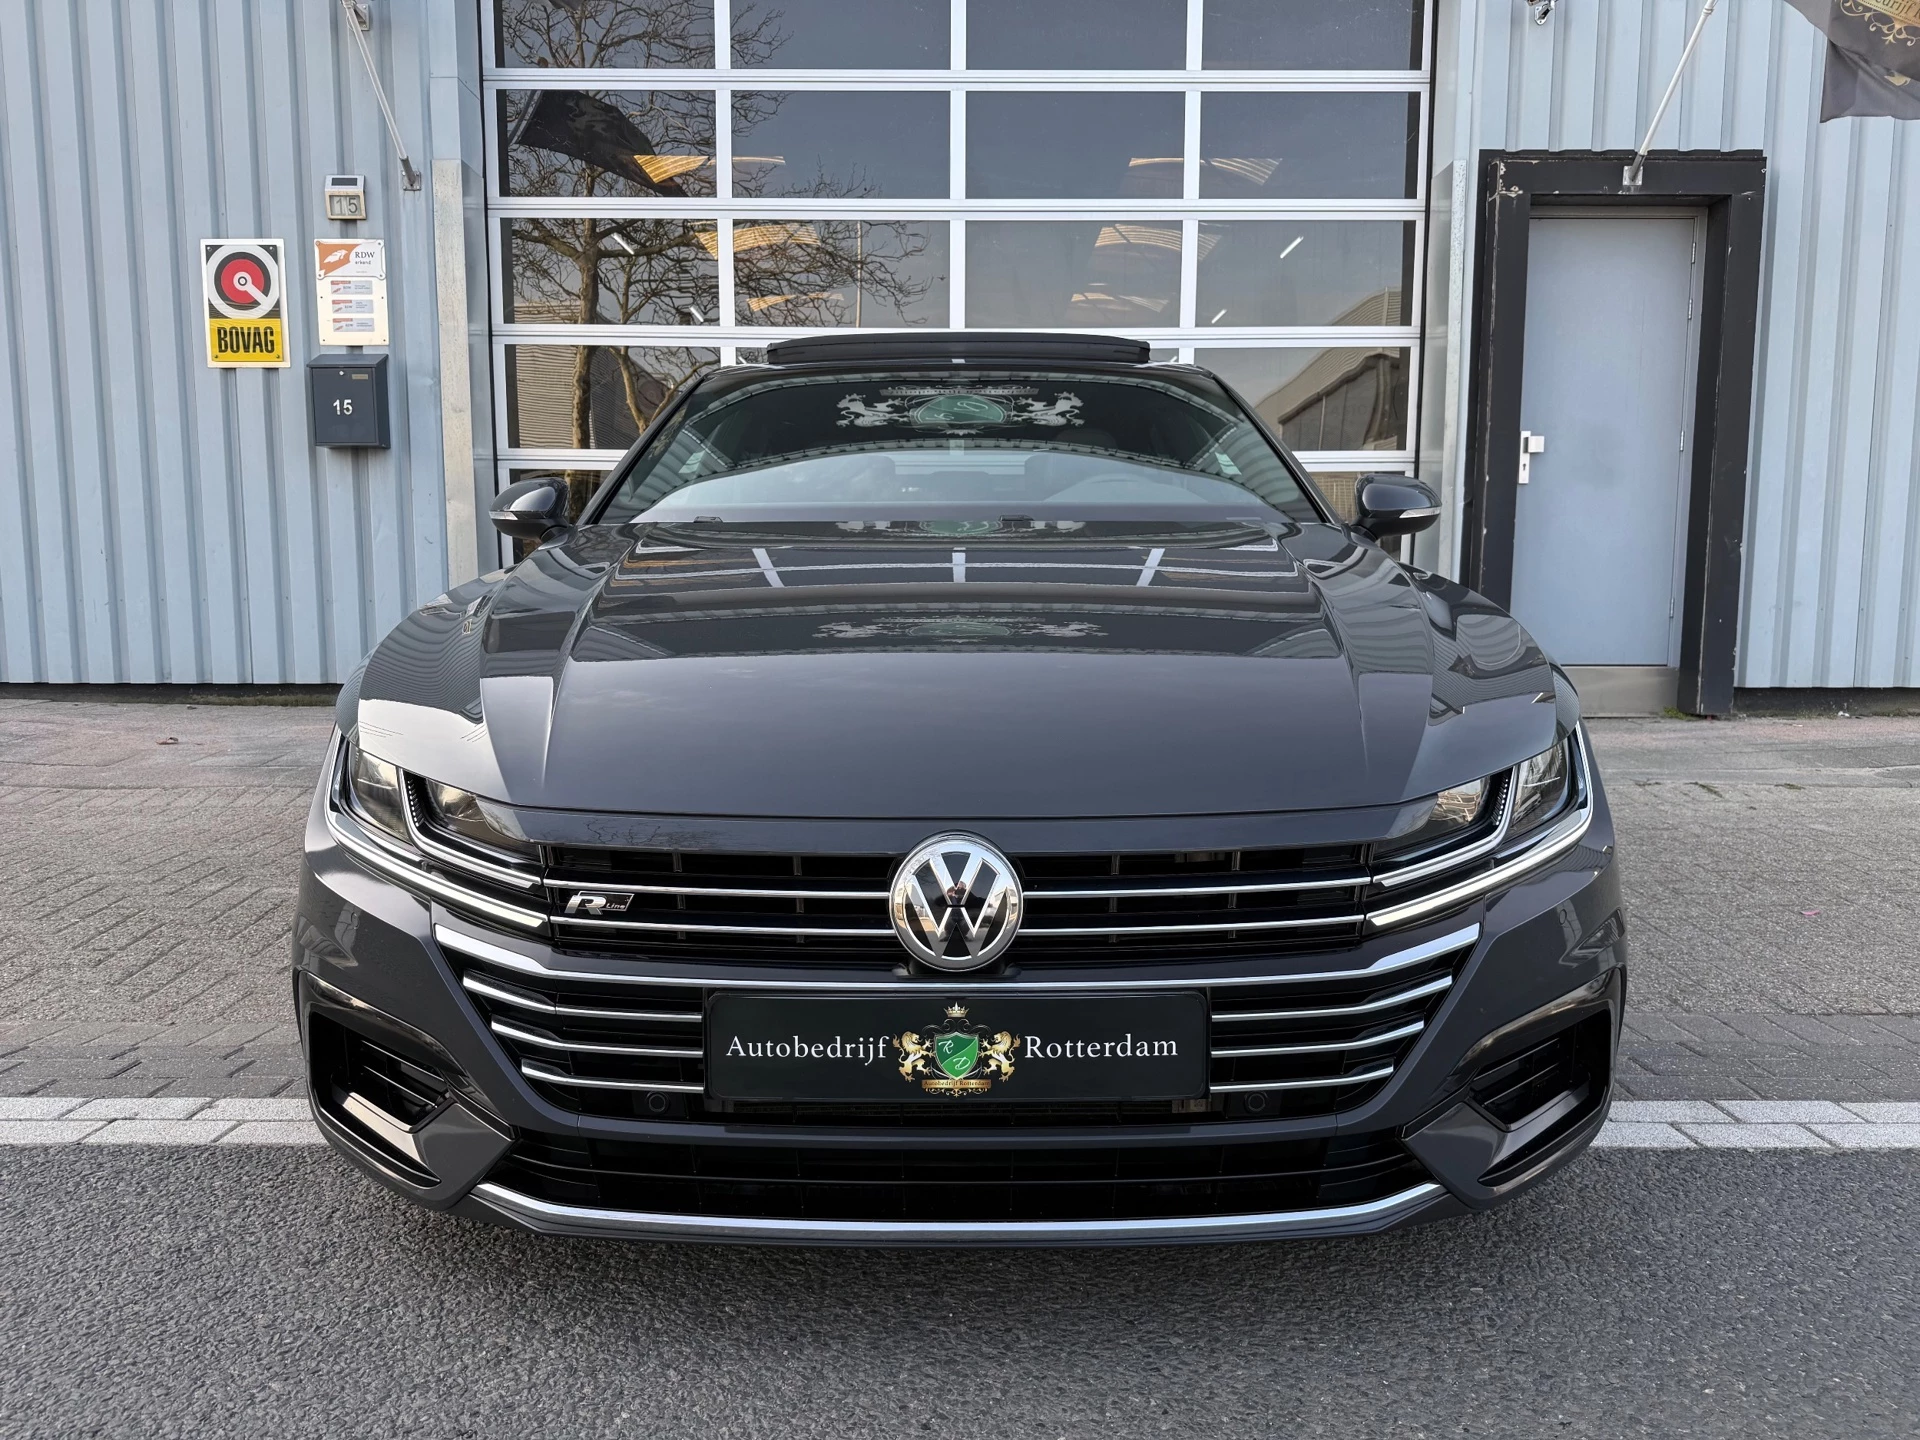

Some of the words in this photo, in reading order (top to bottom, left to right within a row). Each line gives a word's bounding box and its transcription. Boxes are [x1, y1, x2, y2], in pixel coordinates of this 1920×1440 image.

[1876, 0, 1916, 15] drijf
[336, 197, 358, 214] 15
[355, 251, 375, 259] RDW
[217, 326, 275, 353] BOVAG
[333, 399, 353, 415] 15
[895, 838, 1018, 966] VW
[726, 1035, 890, 1066] Autobedrijf
[1024, 1033, 1178, 1059] Rotterdam
